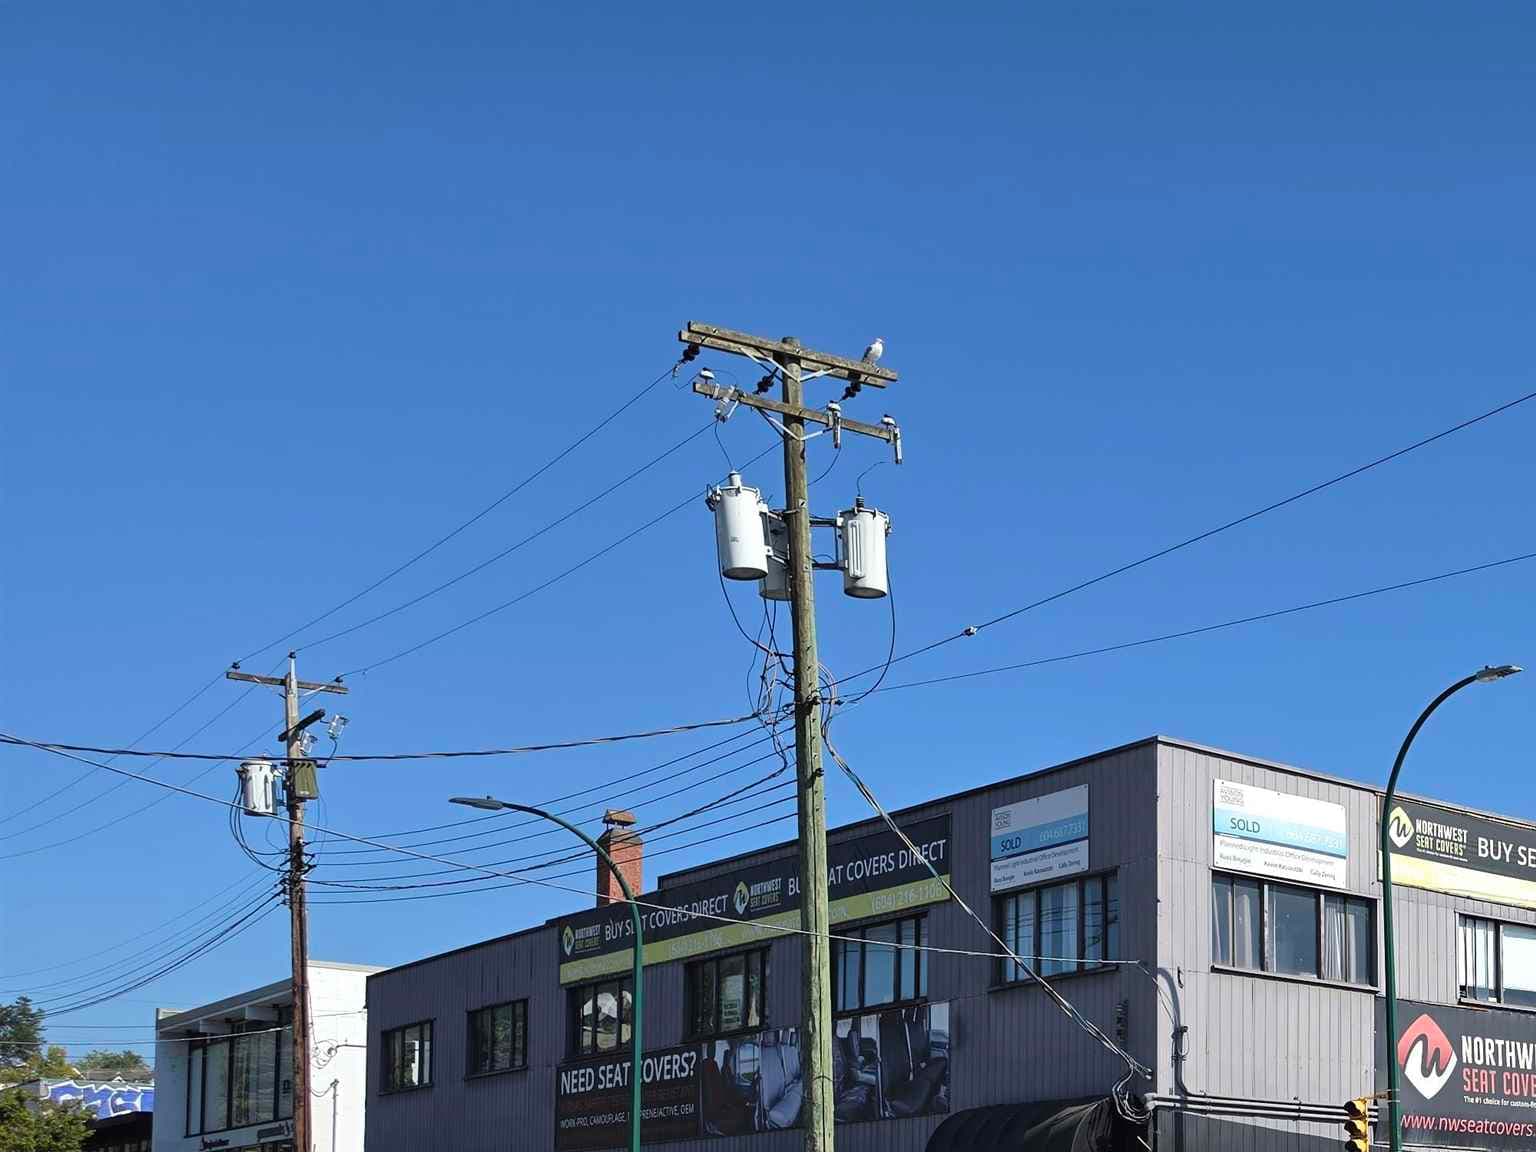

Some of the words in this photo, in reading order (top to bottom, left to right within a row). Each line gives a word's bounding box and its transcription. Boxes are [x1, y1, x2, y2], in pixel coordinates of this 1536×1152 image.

[1229, 817, 1261, 833] SOLD
[1416, 818, 1468, 844] NORTHWEST
[1000, 836, 1022, 852] SOLD
[1416, 837, 1434, 850] SEAT
[1435, 840, 1466, 857] COVERS
[1477, 836, 1515, 864] BUY
[788, 876, 800, 896] BU
[828, 865, 844, 886] AT
[846, 852, 895, 881] COVERS
[900, 839, 947, 869] DIRECT
[750, 877, 782, 895] NORTHWEST
[604, 918, 624, 941] BUY
[625, 912, 647, 936] ST
[649, 904, 689, 929] COVERS
[691, 893, 729, 920] DIRECT
[560, 1067, 595, 1096] NEED
[597, 1062, 632, 1090] SEAT
[640, 1051, 697, 1084] OVERS?
[1462, 1067, 1497, 1095] SEAT
